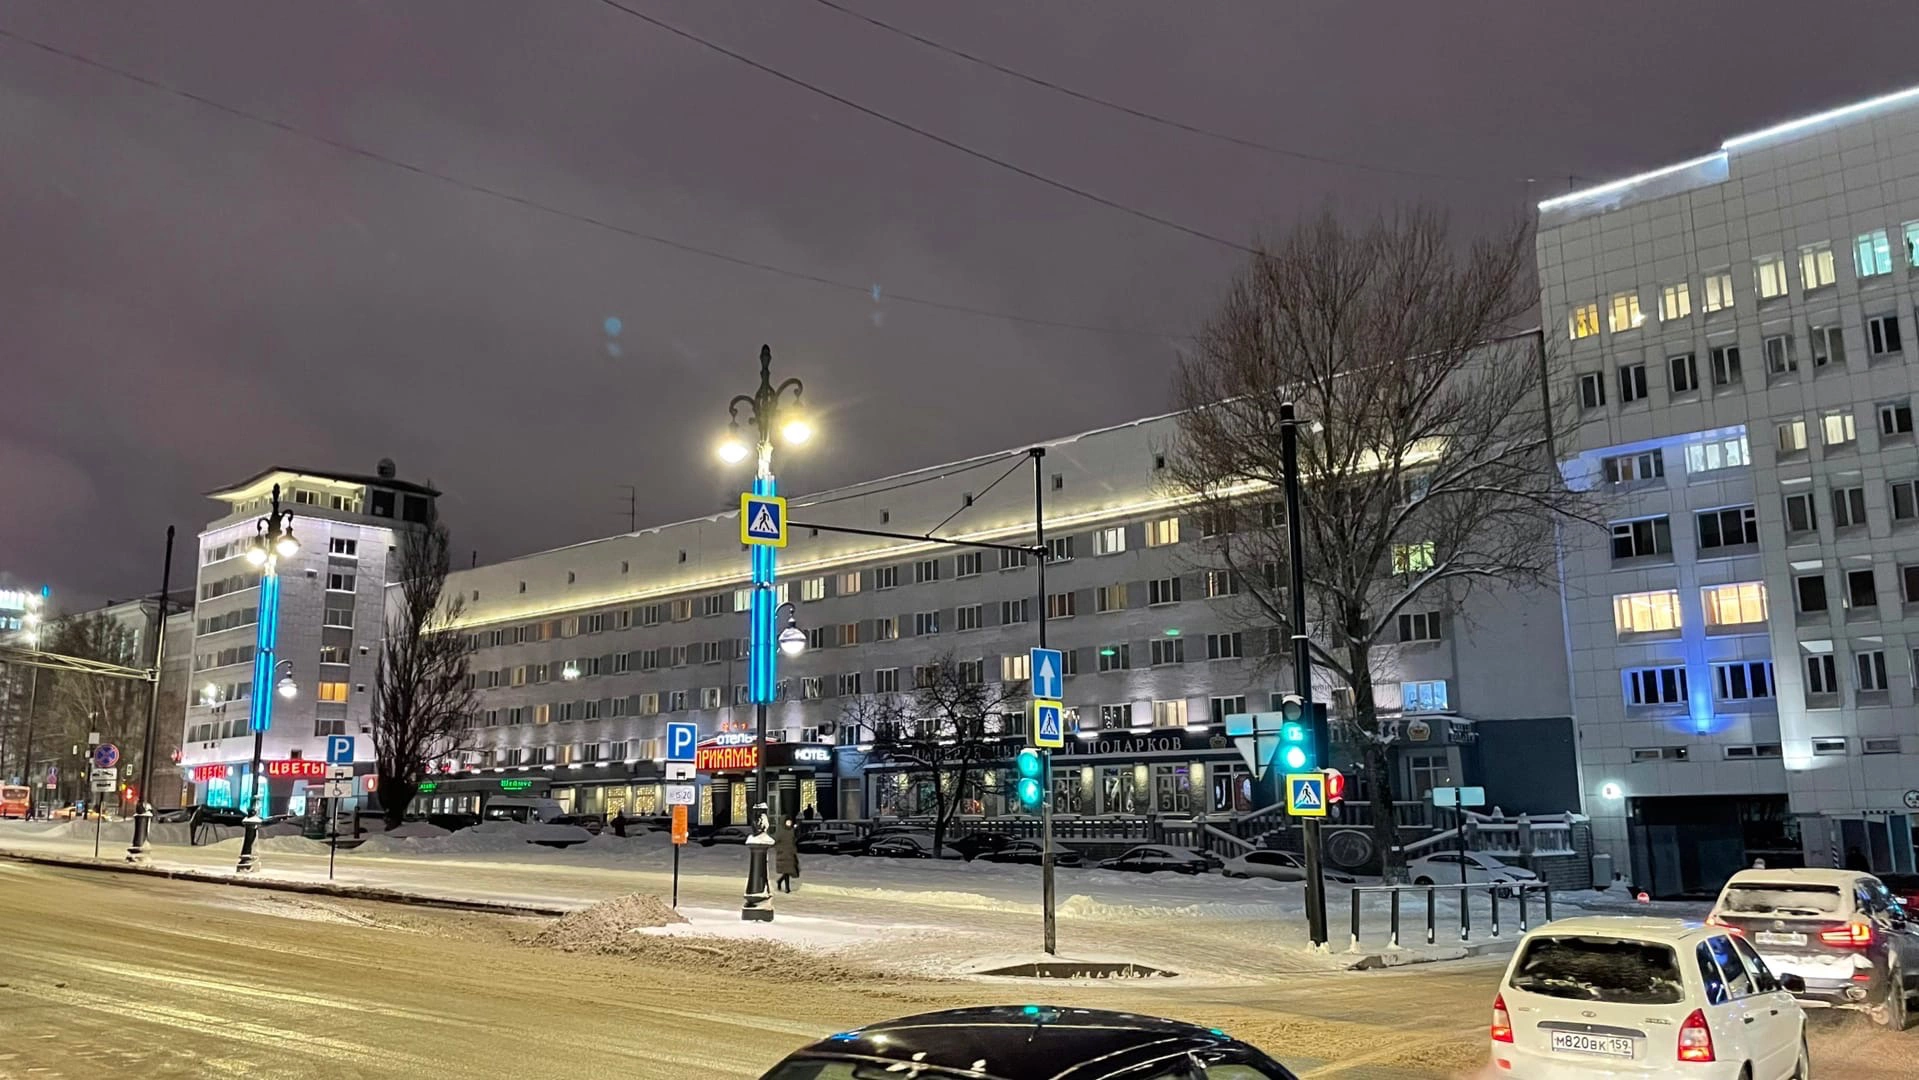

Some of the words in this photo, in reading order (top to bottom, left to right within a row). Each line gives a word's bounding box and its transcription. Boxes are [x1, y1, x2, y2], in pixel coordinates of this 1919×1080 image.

[1087, 737, 1182, 754] ПОДАРКОВ
[697, 747, 757, 769] ПРИКАМЬЕ
[795, 750, 831, 761] HOTEL
[194, 766, 226, 781] ЦВЕТЫ
[269, 762, 324, 775] ЦВЕТЫ
[1610, 1039, 1628, 1050] 159
